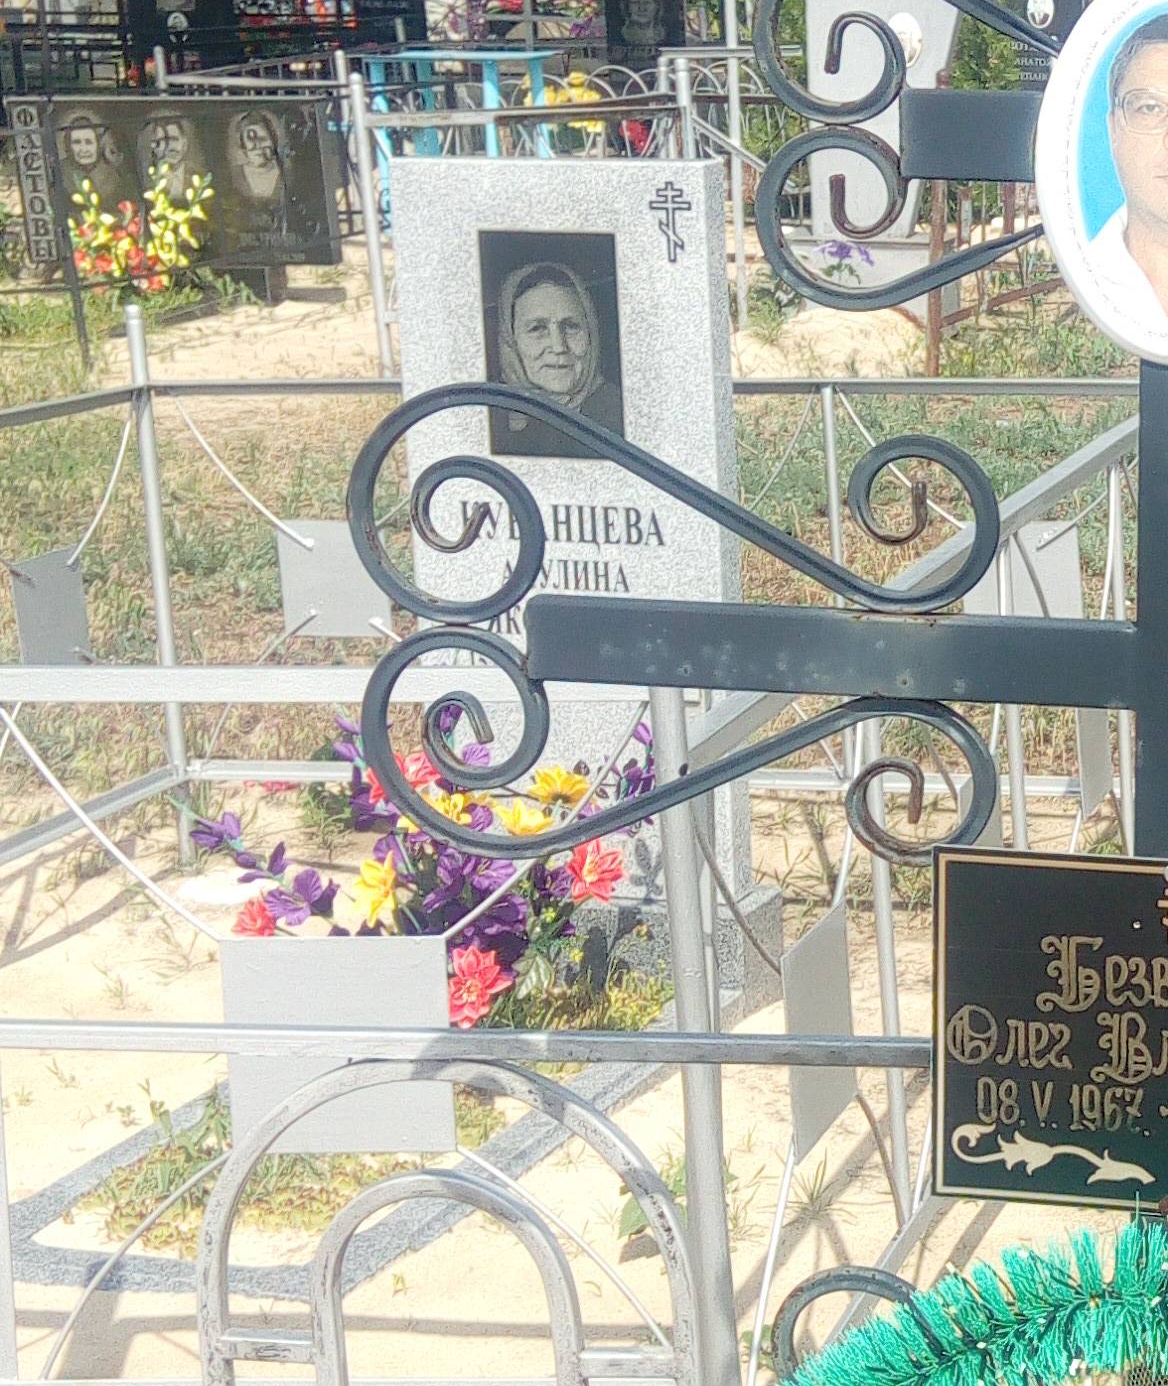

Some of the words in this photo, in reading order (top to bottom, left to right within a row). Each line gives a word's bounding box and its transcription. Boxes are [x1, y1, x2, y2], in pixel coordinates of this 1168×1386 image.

[461, 499, 665, 553] КУНЦЕВА
[502, 557, 631, 594] АУЛИНА
[947, 1005, 1074, 1071] Олег
